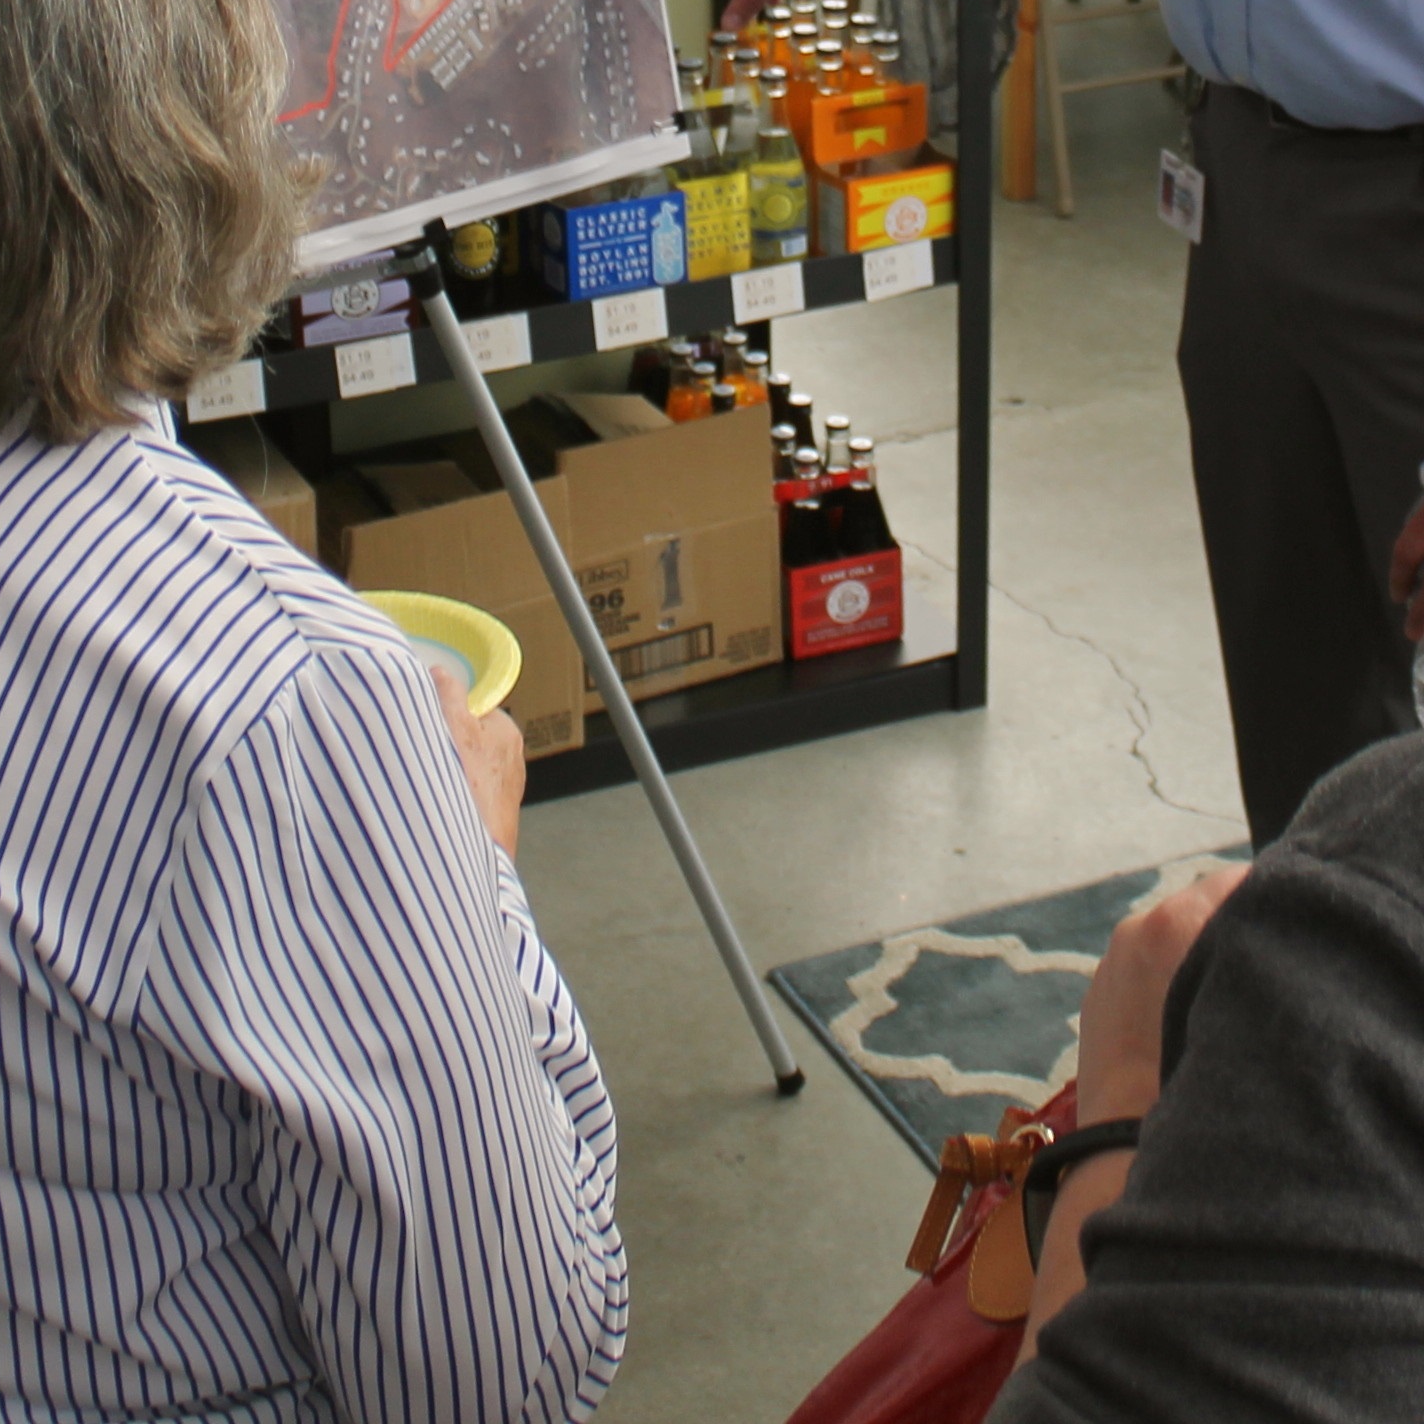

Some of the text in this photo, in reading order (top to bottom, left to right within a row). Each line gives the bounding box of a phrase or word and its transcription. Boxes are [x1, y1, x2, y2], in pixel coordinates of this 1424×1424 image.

[576, 207, 647, 229] CLASSIC
[577, 219, 648, 241] SELTZER
[578, 243, 649, 265] BOYLAN
[578, 255, 649, 278] BOTTLING
[579, 274, 611, 289] EST.
